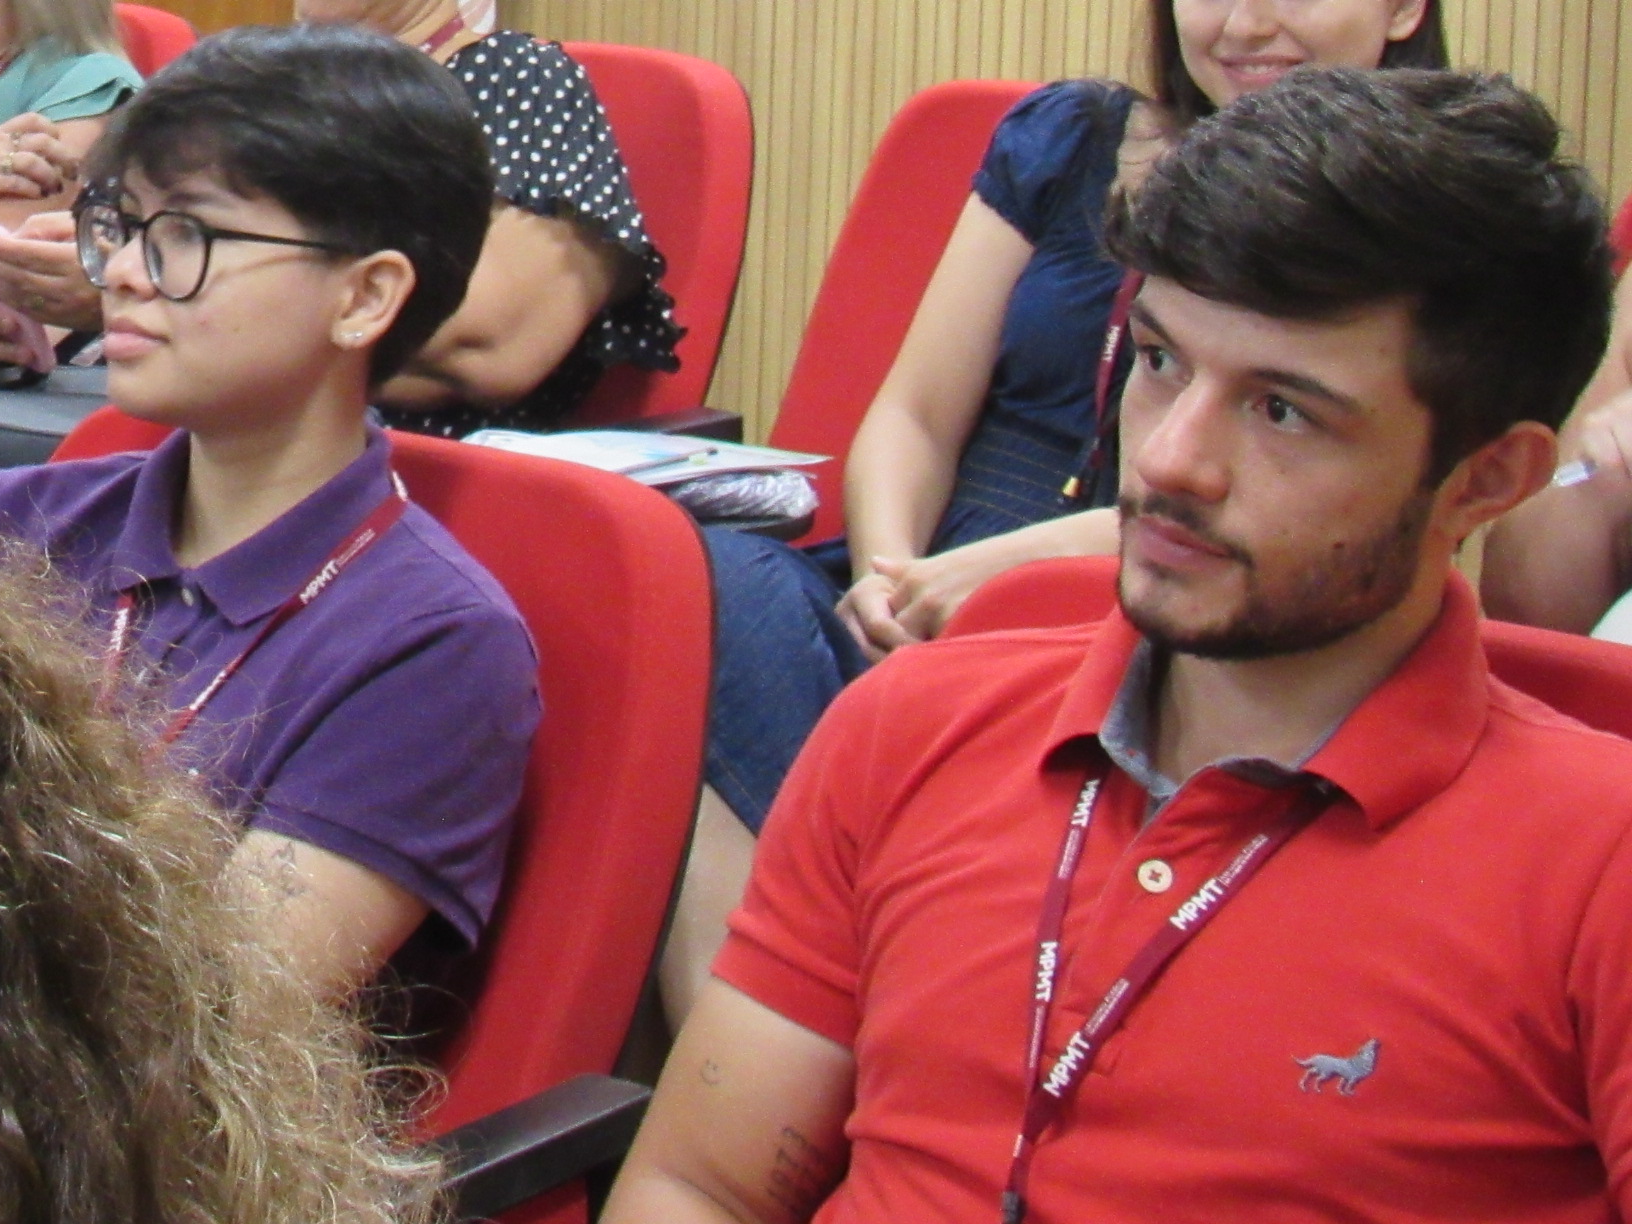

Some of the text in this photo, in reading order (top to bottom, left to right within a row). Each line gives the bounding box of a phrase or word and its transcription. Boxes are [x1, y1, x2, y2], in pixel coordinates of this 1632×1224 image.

[299, 559, 339, 605] MPMT
[1070, 779, 1100, 827] MPMT
[1169, 877, 1224, 930] MPMT
[1034, 941, 1058, 1002] MPMT
[1042, 1031, 1090, 1098] MPMT
